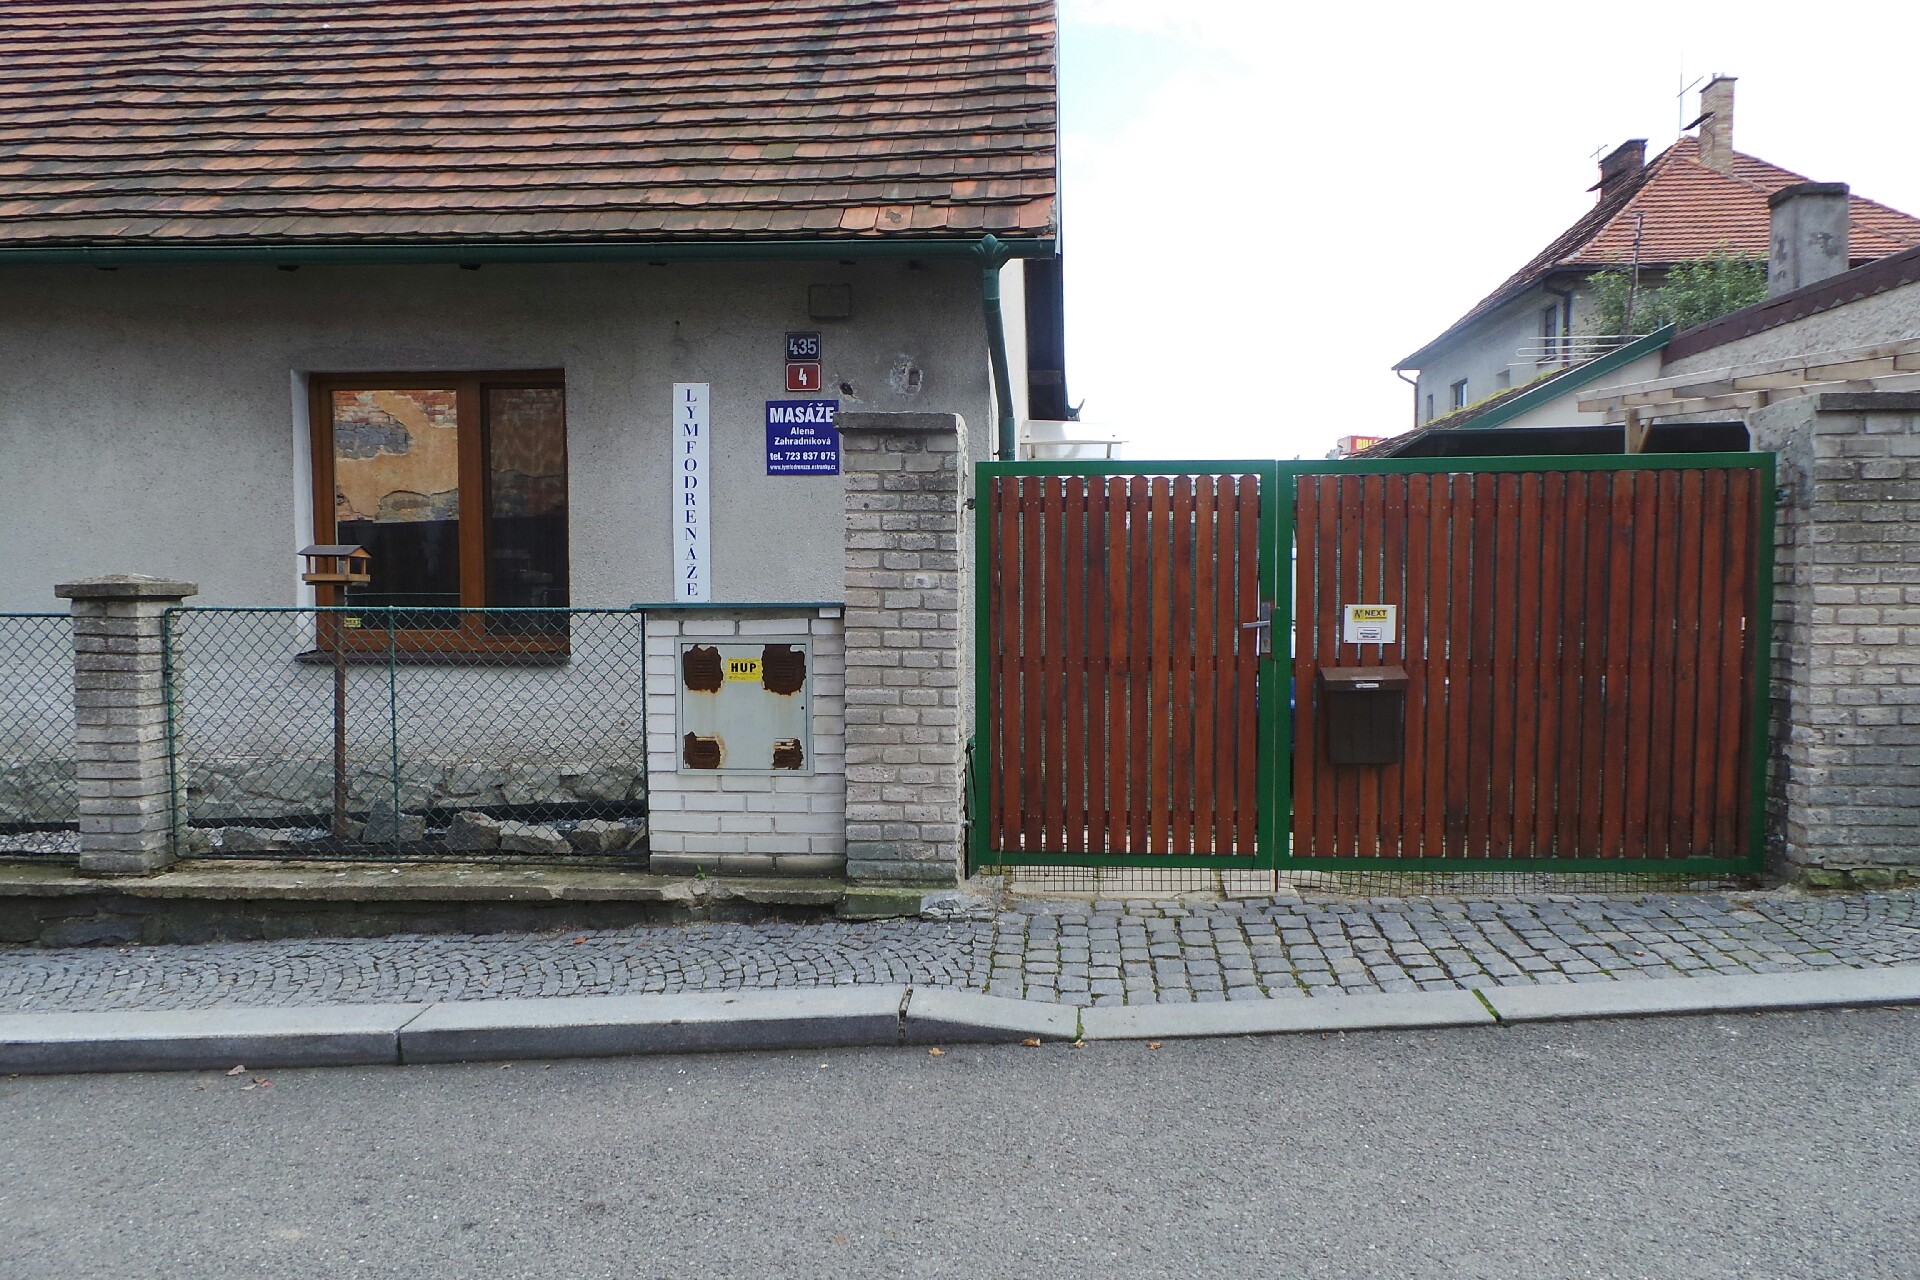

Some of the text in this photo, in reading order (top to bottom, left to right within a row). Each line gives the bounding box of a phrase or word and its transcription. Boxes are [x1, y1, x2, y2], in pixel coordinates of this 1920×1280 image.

[789, 338, 817, 355] 435
[798, 368, 808, 386] 4
[769, 402, 835, 424] MASÁŽE
[790, 426, 815, 436] Alena
[774, 436, 831, 446] Zahradníková
[769, 451, 836, 461] tel. 723 837 875
[682, 388, 699, 597] LYMFODRENÁŽE
[730, 662, 757, 673] HUP
